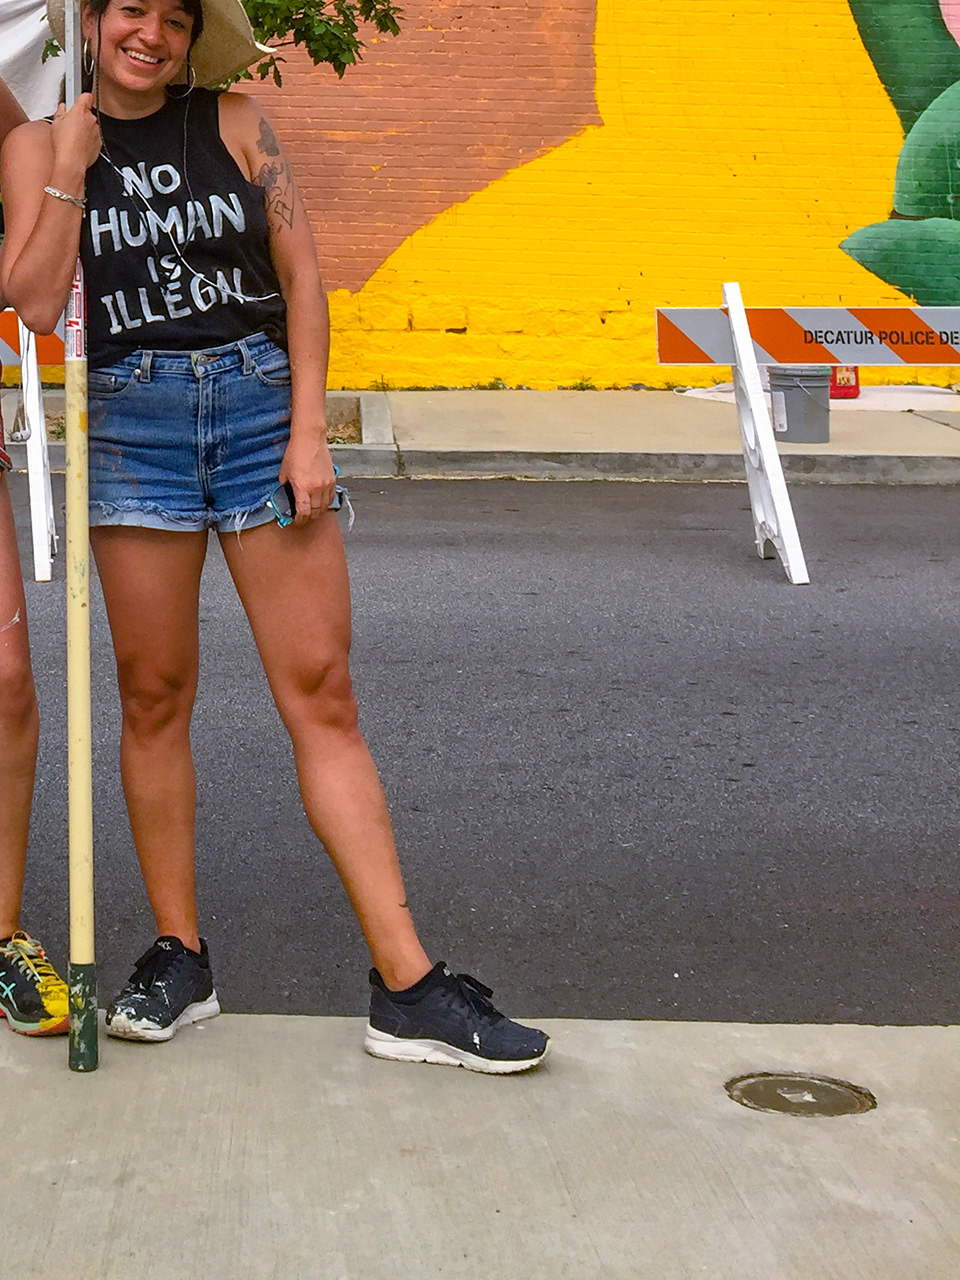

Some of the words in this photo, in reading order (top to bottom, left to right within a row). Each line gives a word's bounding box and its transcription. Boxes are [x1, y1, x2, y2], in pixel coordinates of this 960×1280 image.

[121, 161, 181, 199] NO
[90, 192, 246, 257] HUMAN
[146, 253, 182, 283] IS
[803, 329, 874, 345] DECATUR
[878, 330, 936, 346] POLICE
